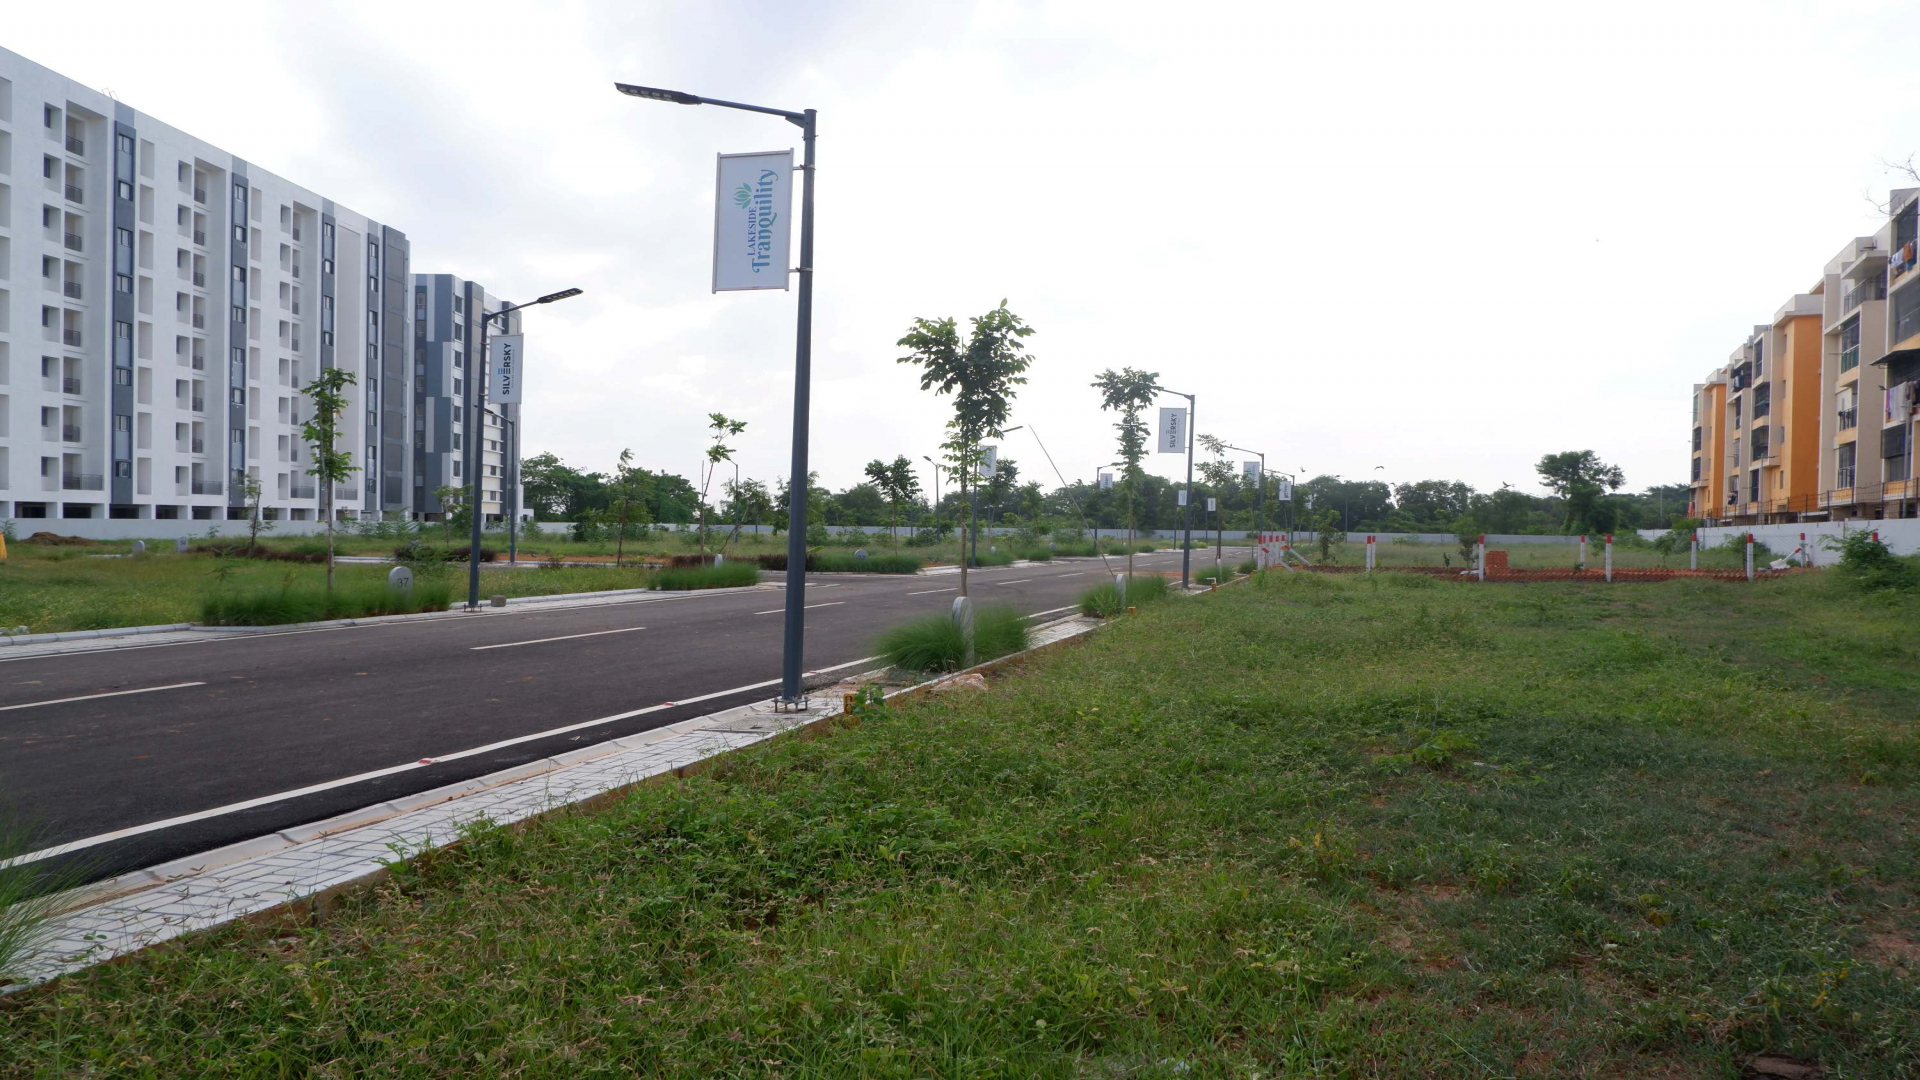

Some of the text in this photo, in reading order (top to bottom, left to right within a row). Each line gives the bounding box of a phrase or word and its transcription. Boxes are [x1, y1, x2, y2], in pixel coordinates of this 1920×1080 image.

[747, 206, 757, 256] LAKESIDE
[751, 169, 778, 273] Tranquility
[502, 343, 512, 395] SILVERSKY
[1169, 413, 1177, 448] SILVERSKY
[397, 577, 410, 588] 37
